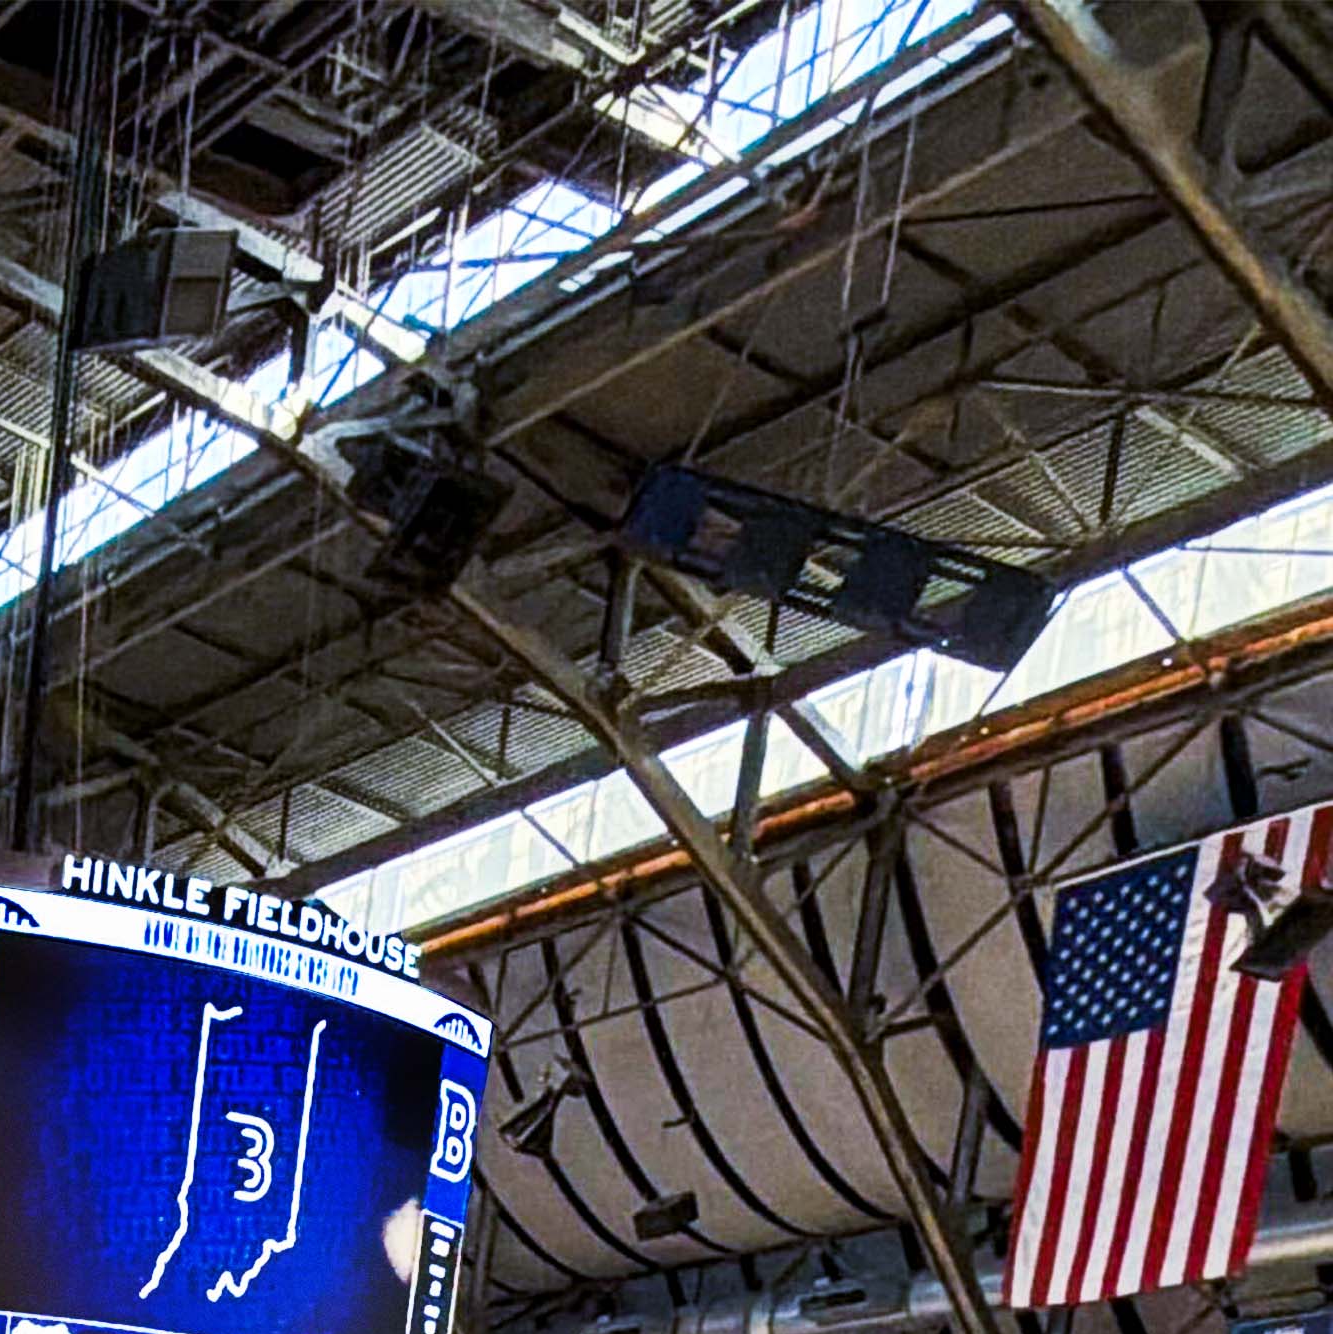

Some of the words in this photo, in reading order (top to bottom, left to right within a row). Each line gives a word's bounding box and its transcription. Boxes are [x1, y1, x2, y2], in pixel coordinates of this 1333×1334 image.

[62, 853, 213, 916] HINKLE
[223, 886, 422, 979] FIELDHOUSE
[429, 1078, 476, 1184] B
